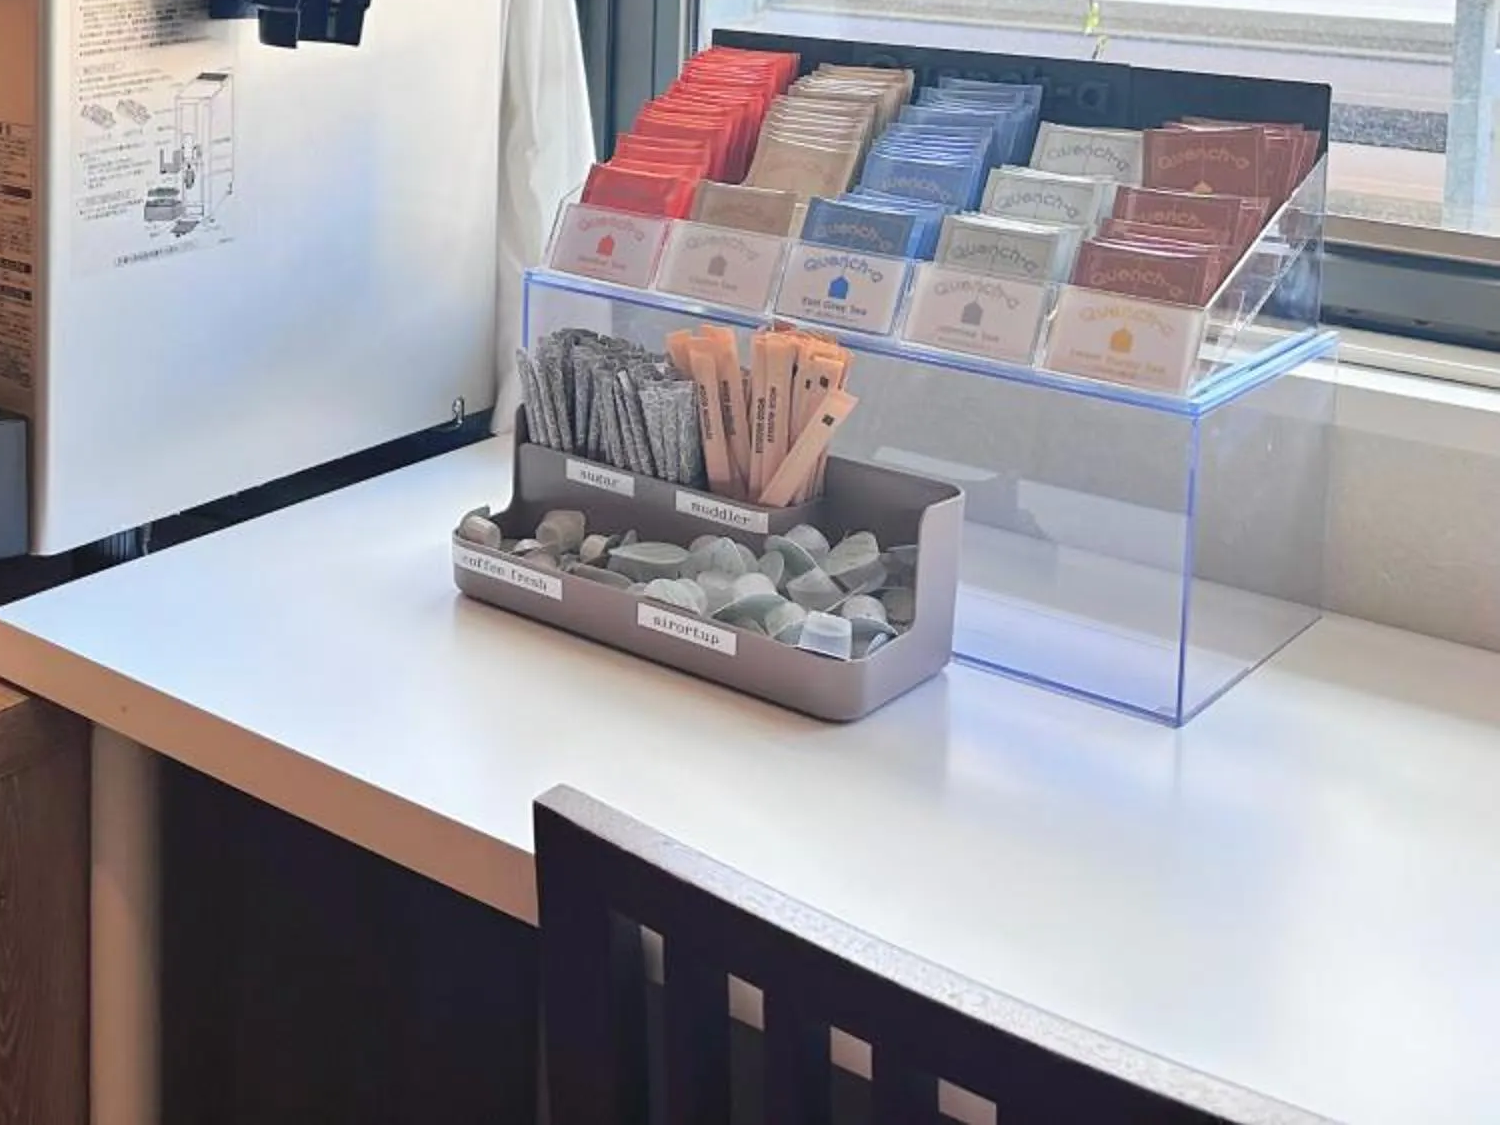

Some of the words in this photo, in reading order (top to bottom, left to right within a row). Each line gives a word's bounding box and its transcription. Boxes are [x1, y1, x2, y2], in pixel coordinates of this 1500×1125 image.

[579, 468, 619, 490] sugar
[691, 501, 752, 525] muddler
[462, 555, 505, 575] coffee
[509, 566, 549, 592] fresh
